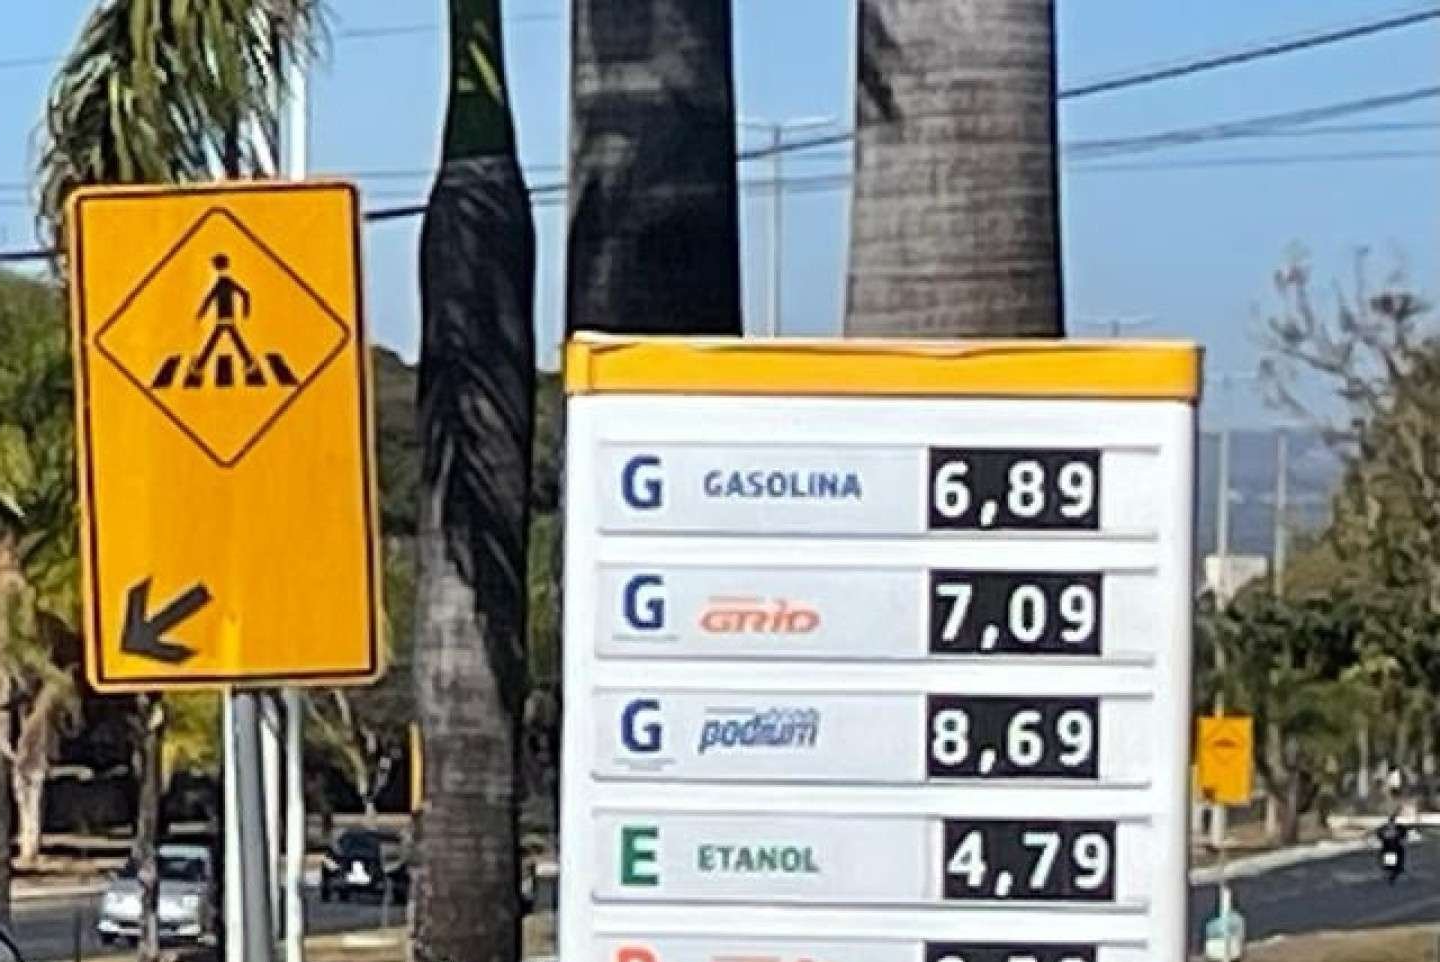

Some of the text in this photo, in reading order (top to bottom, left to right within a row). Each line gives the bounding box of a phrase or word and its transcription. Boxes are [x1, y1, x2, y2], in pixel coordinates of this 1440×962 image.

[621, 456, 1095, 527] G GASOLINA 6,89
[623, 574, 665, 630] G
[937, 583, 1096, 650] 7,09
[621, 699, 662, 752] G
[932, 708, 1094, 774] 8,69
[619, 827, 1111, 897] E ETANOL 4,79
